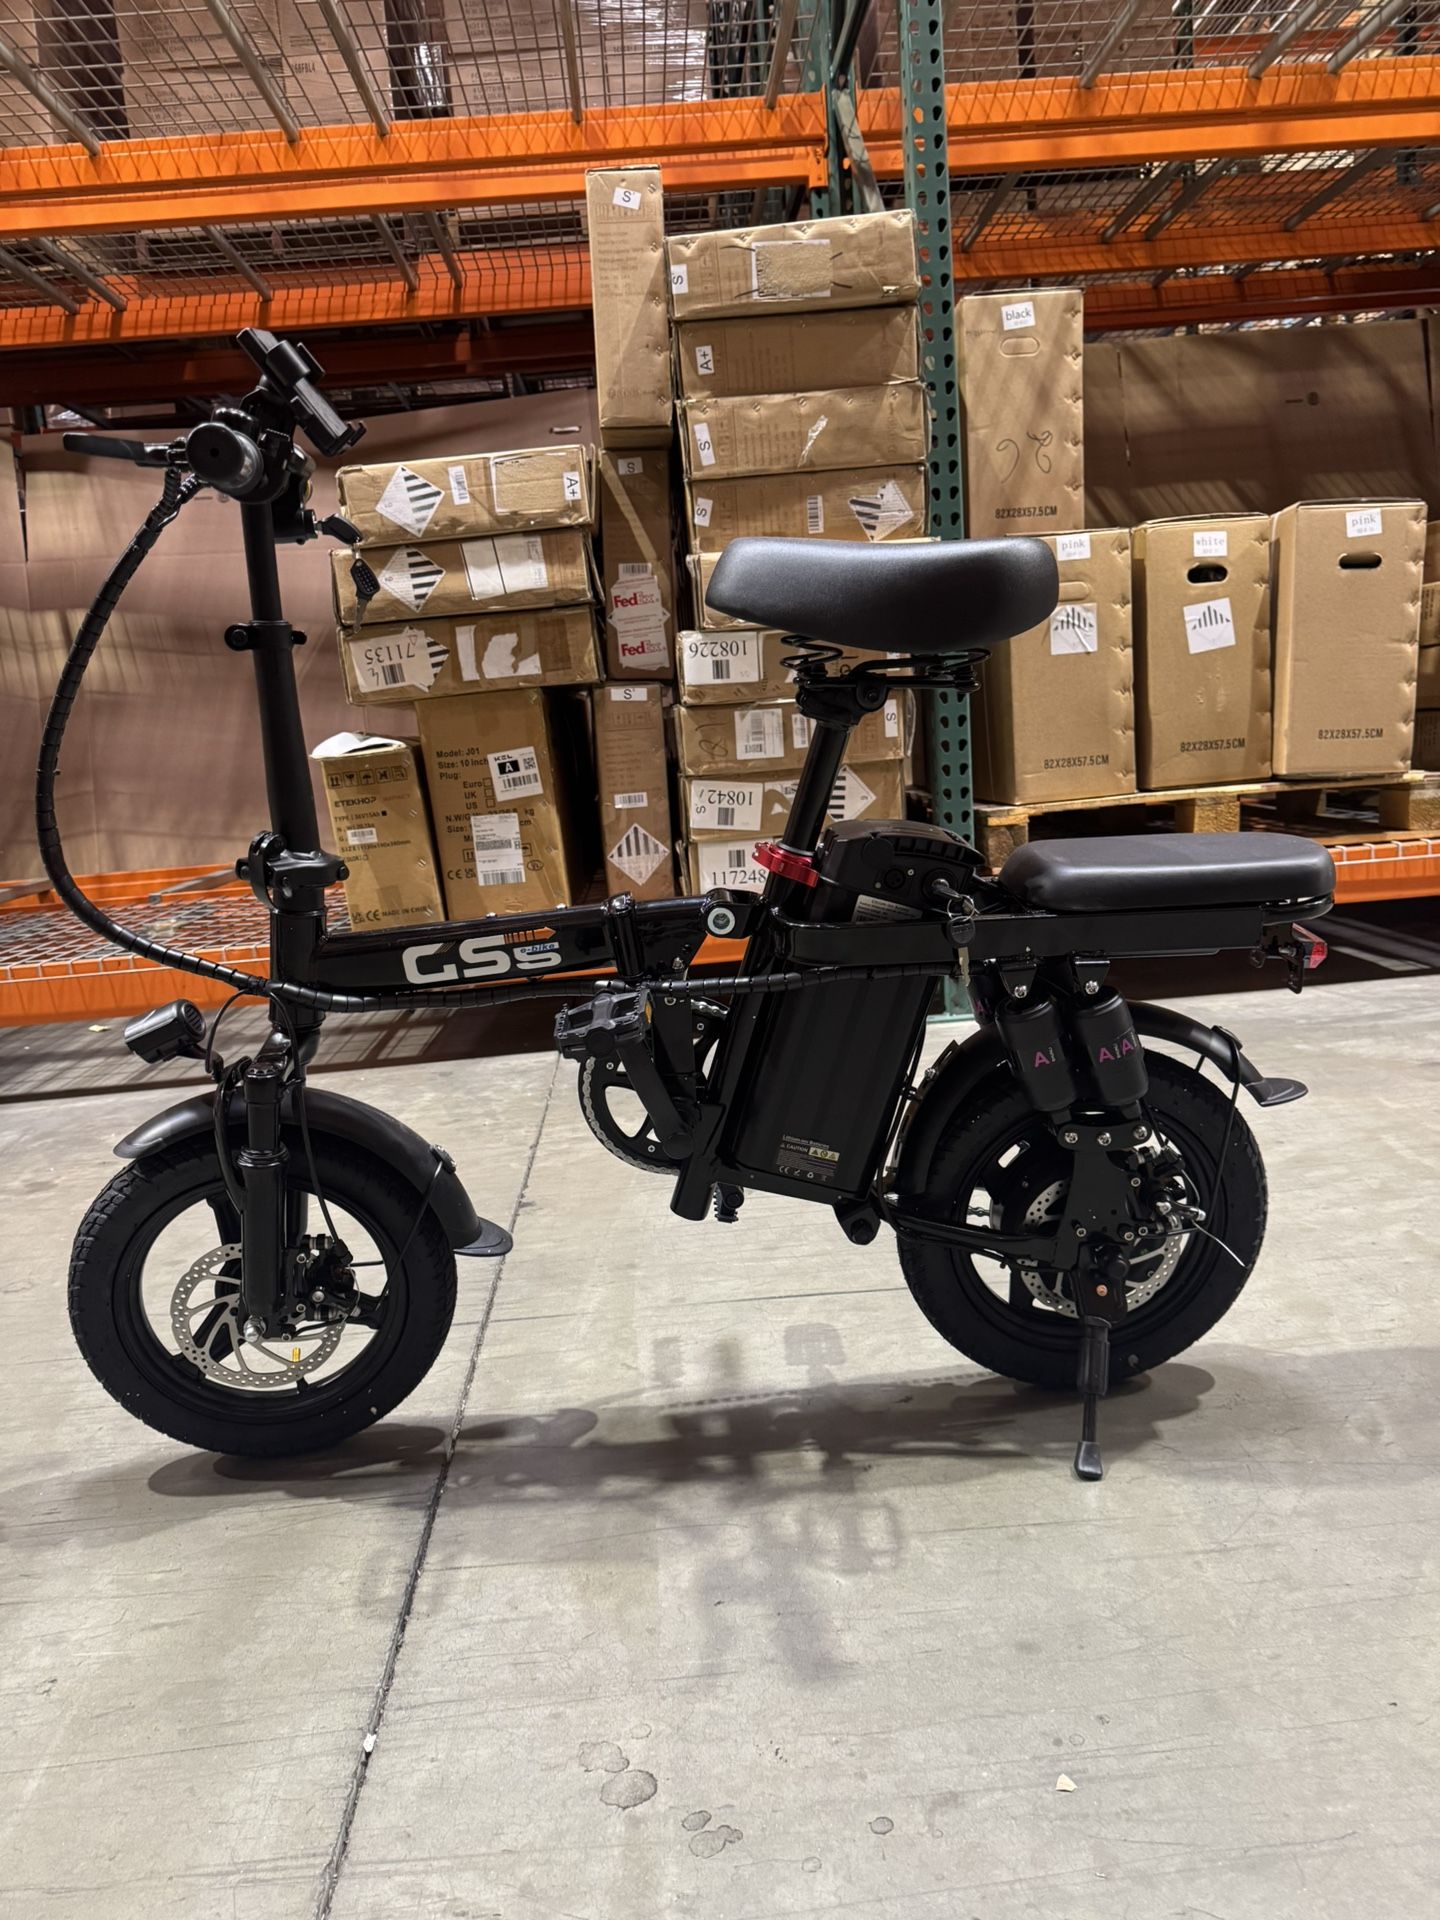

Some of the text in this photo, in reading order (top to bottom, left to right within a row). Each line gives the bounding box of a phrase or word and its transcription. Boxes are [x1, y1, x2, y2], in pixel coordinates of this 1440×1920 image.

[622, 190, 632, 203] S
[672, 275, 684, 285] S
[1005, 307, 1032, 321] black
[700, 350, 712, 371] A+
[699, 440, 711, 452] S
[626, 462, 635, 473] S
[566, 476, 579, 497] A+
[696, 507, 708, 518] S
[1352, 514, 1377, 527] pink
[1062, 540, 1087, 551] pink
[364, 642, 415, 665] 71135
[689, 640, 747, 658] 108226
[623, 688, 633, 700] S
[886, 712, 897, 722] S
[436, 749, 464, 758] Model:
[438, 758, 488, 769] Size: 10 inch
[505, 763, 514, 773] A
[466, 802, 478, 810] US
[696, 805, 706, 814] S
[712, 868, 767, 886] 117248
[520, 943, 555, 954] e-bike
